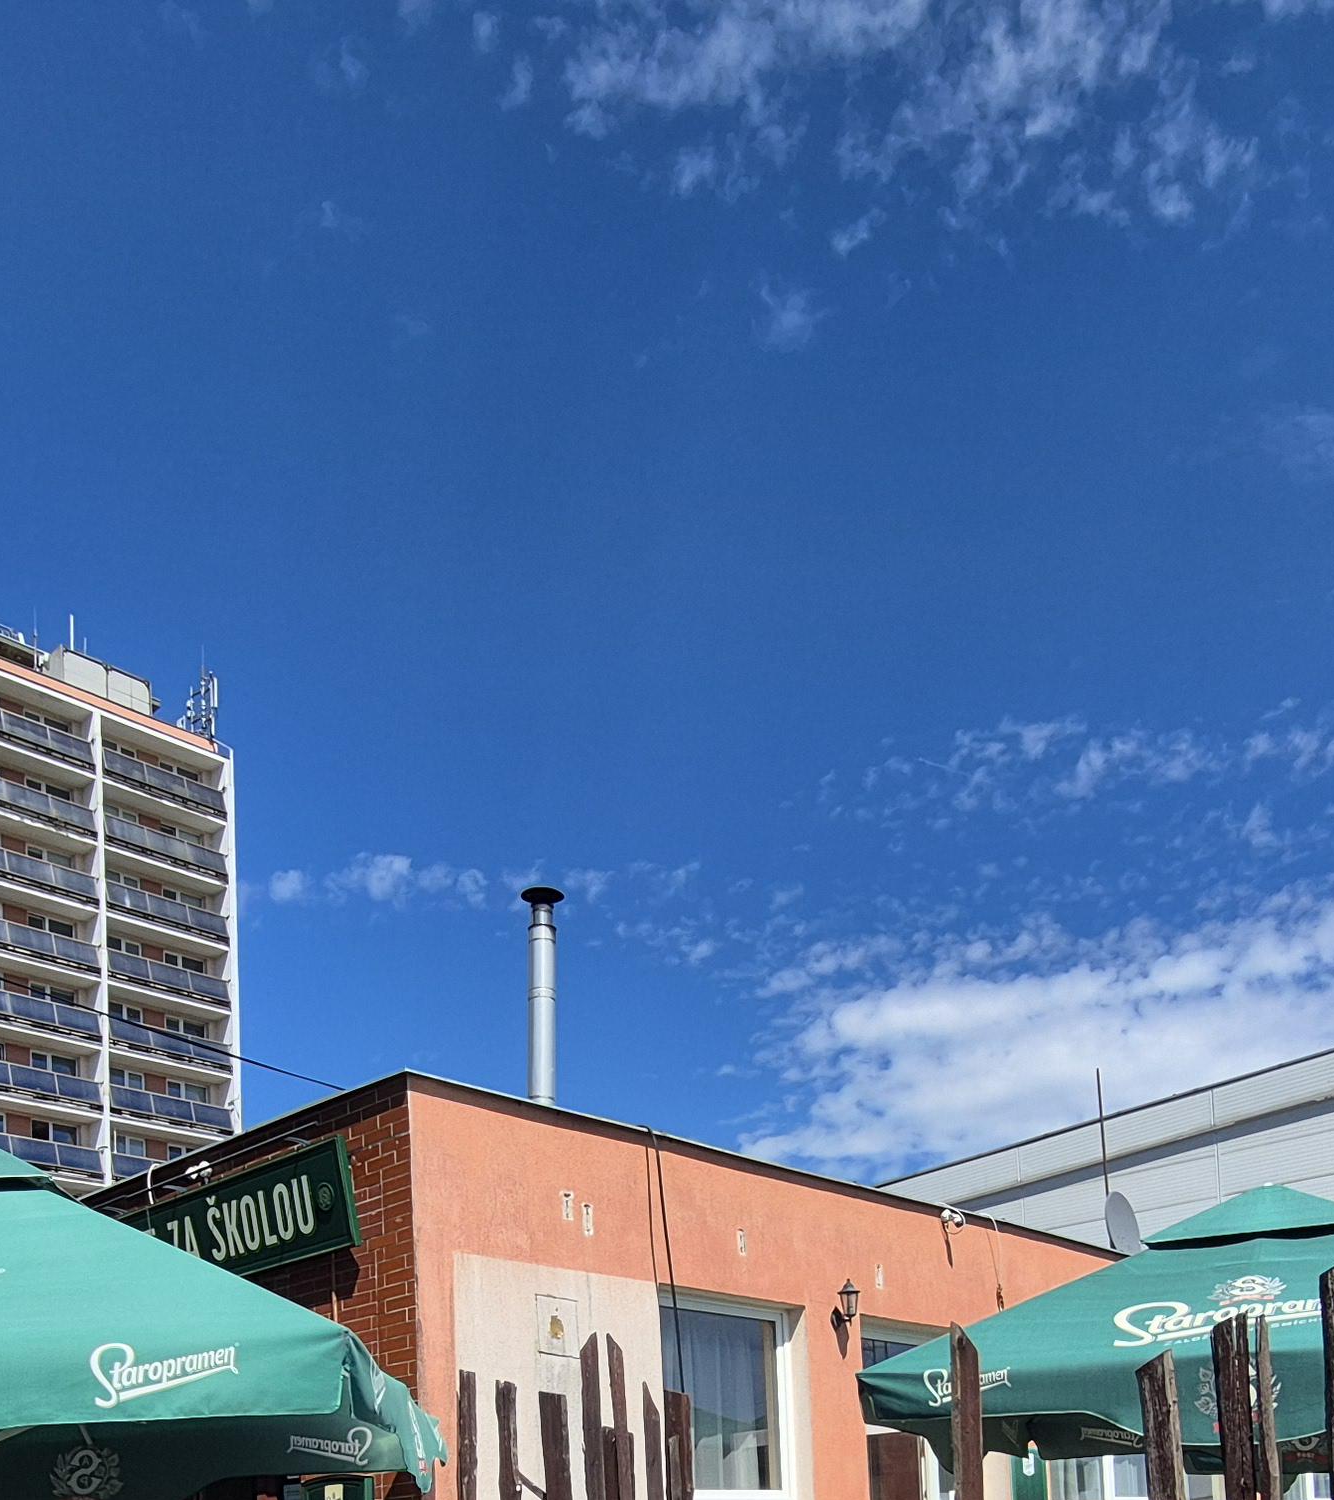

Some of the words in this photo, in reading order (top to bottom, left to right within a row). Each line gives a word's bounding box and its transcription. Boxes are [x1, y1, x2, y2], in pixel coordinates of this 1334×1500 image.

[206, 1174, 316, 1262] ŠKOLOU
[1113, 1298, 1322, 1347] Staropram
[90, 1343, 240, 1409] Staropramen
[923, 1367, 1012, 1408] Staamen
